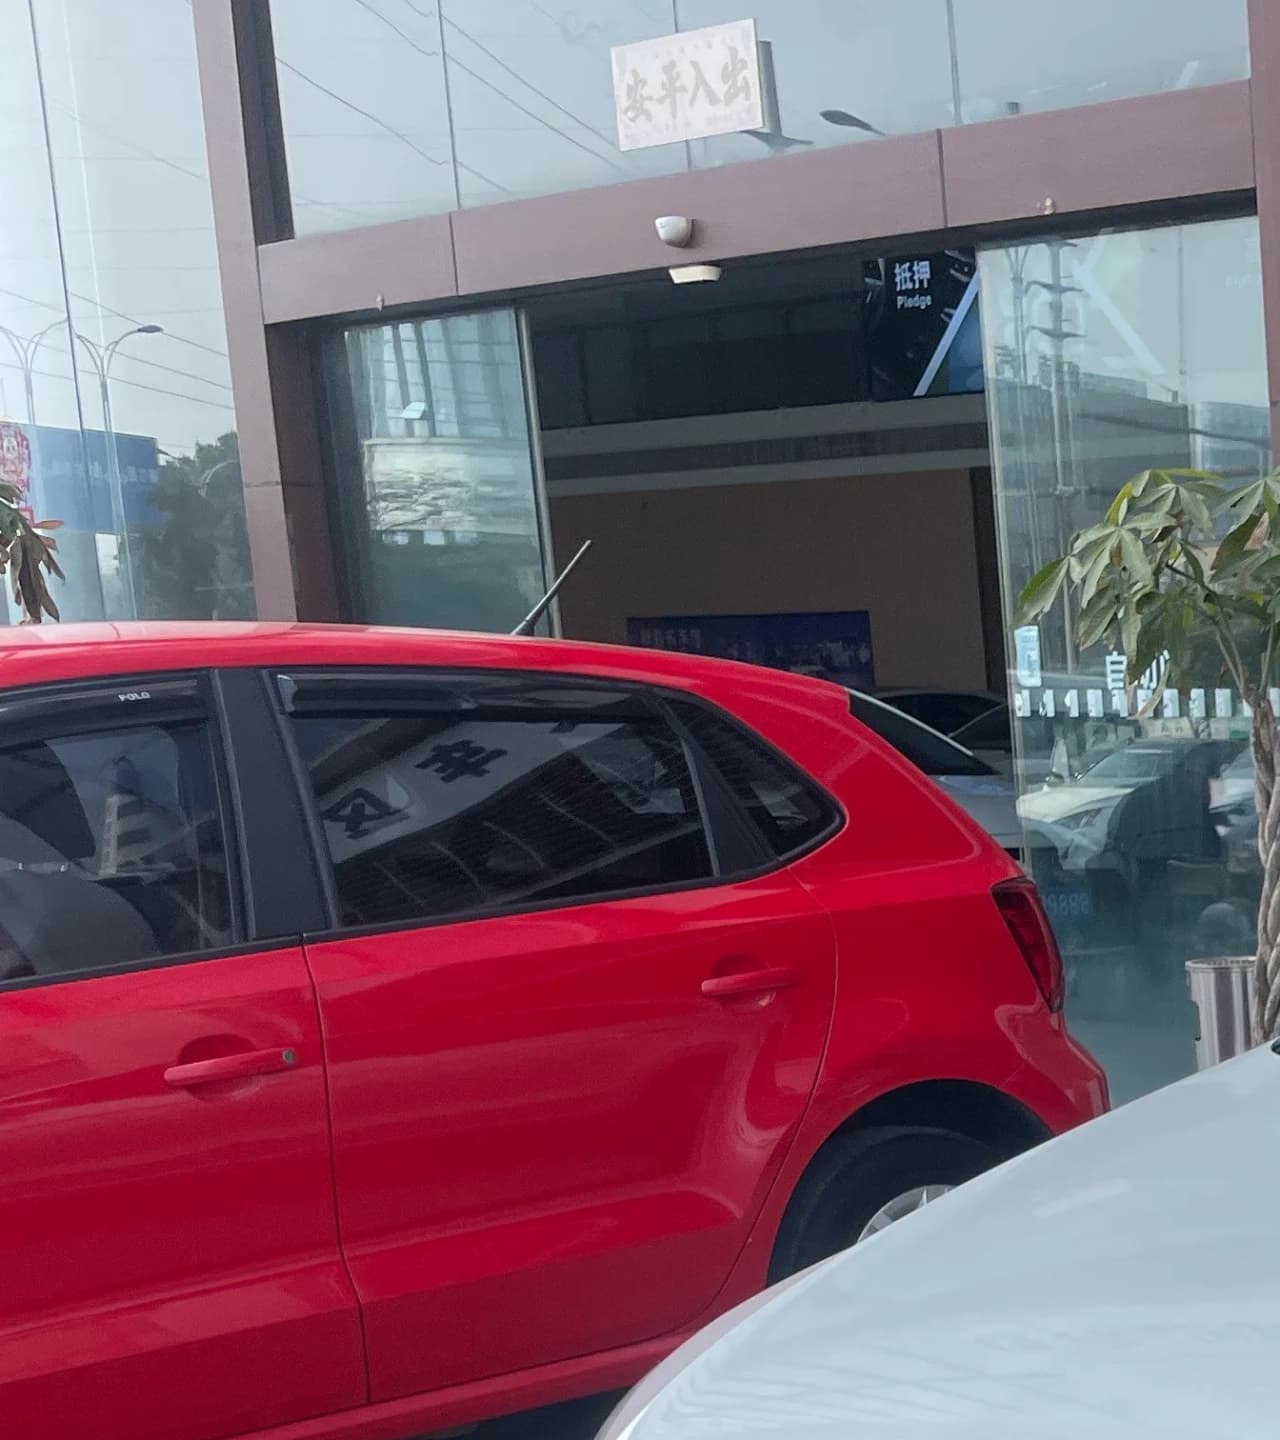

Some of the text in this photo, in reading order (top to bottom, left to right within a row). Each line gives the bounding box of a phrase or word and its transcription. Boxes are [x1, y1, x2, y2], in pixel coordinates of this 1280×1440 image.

[894, 260, 931, 291] 抵押
[896, 294, 933, 310] Pledge
[118, 691, 152, 702] POLO
